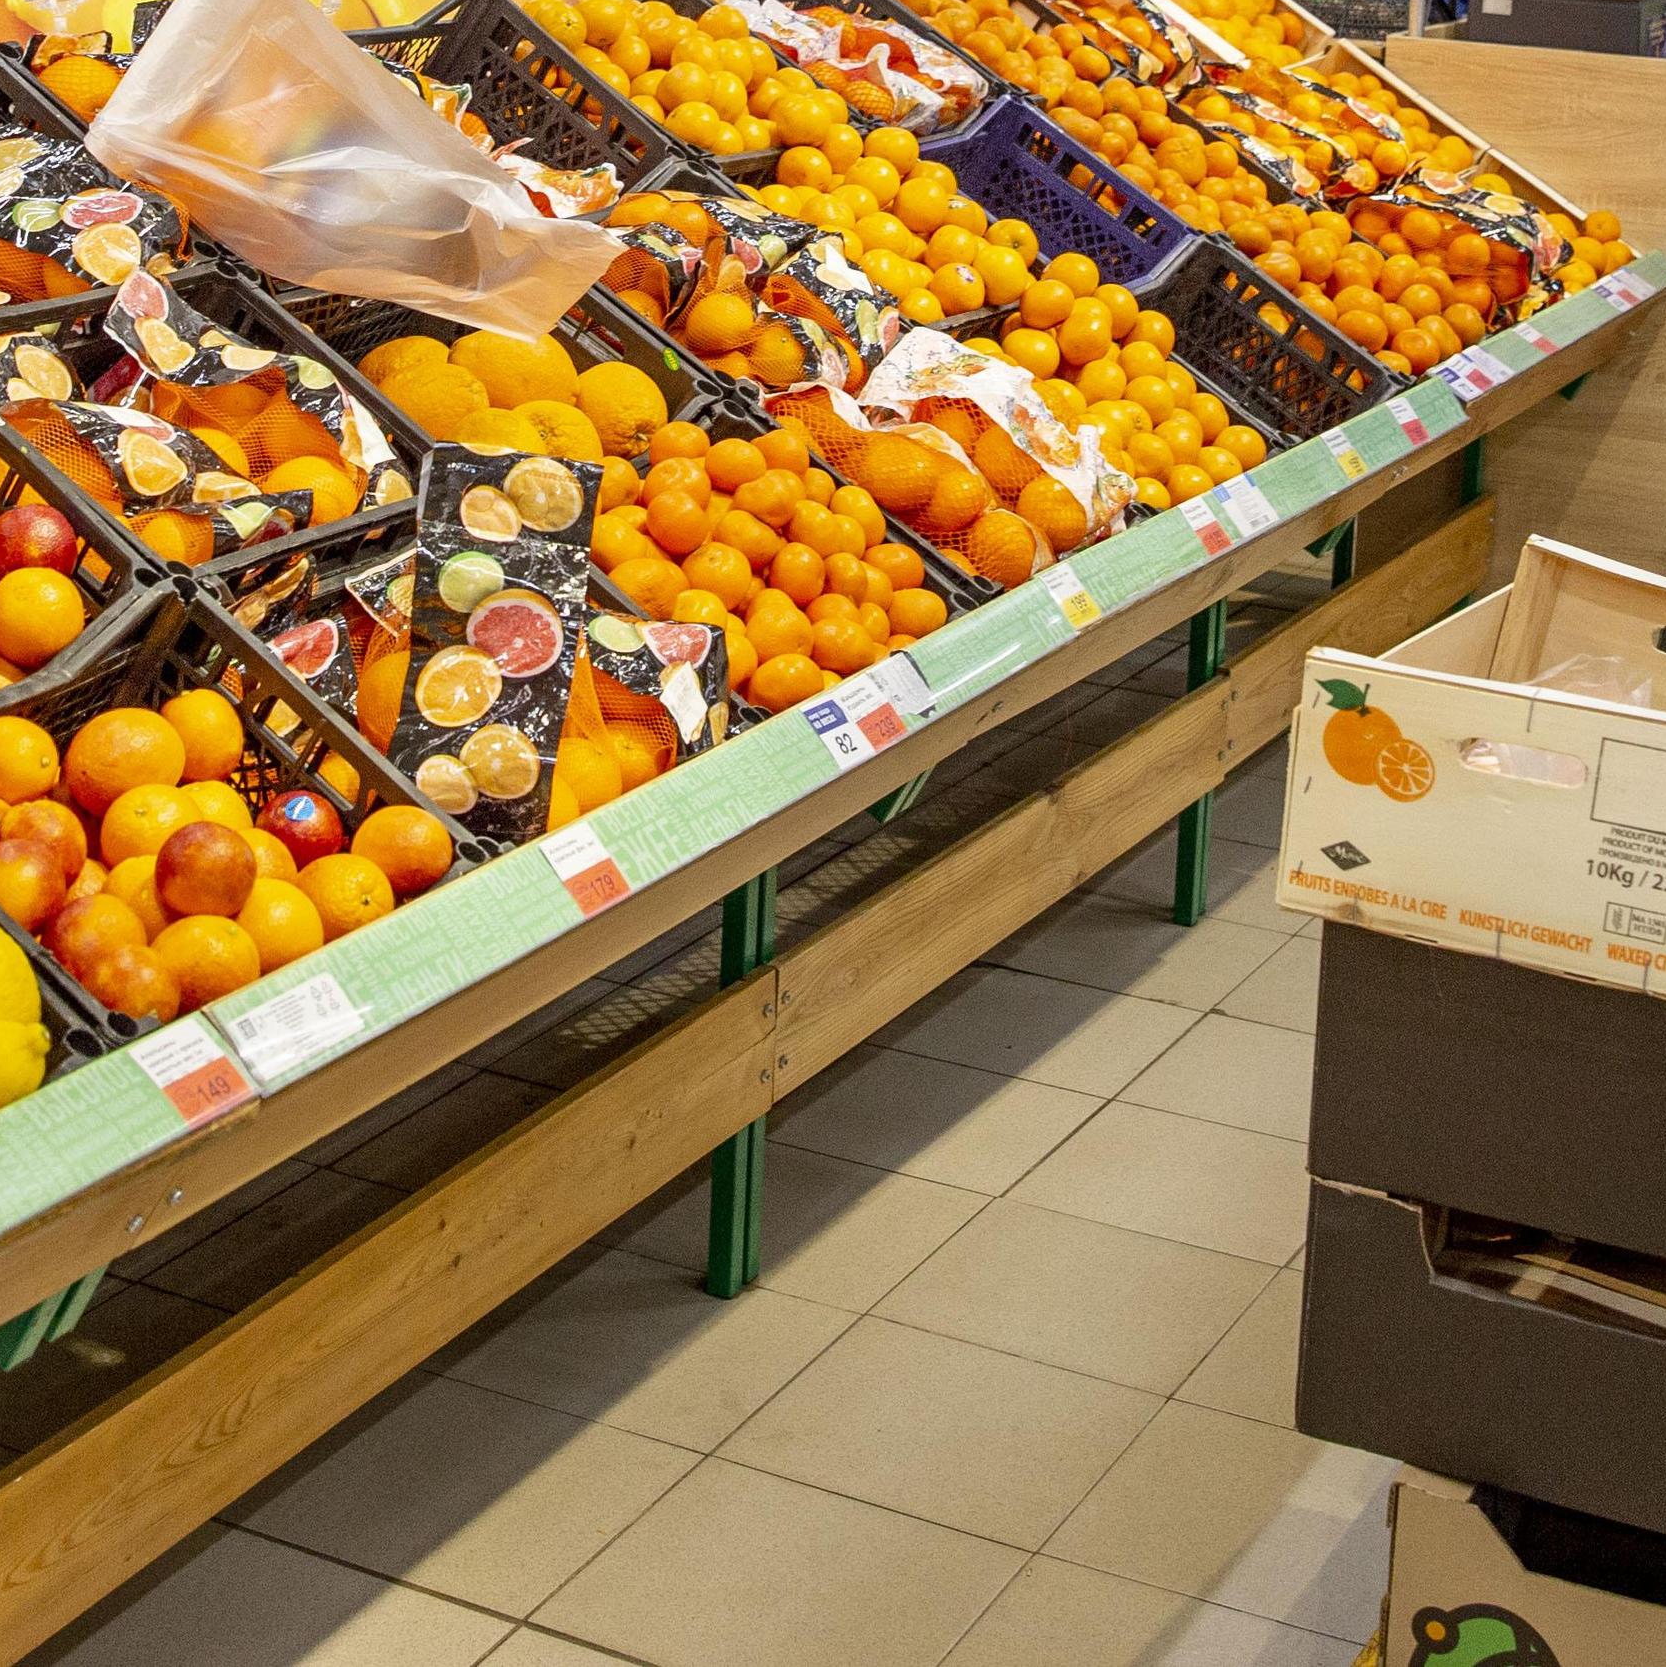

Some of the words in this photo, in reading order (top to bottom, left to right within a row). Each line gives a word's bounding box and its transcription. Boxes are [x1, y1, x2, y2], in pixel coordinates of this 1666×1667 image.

[837, 733, 857, 754] 82
[1602, 837, 1642, 852] PRODUCT
[1642, 844, 1654, 855] OF
[1611, 827, 1647, 842] PRODUIT
[1647, 834, 1661, 845] DU
[588, 872, 617, 900] 179
[1586, 859, 1635, 888] 10Kg
[1288, 870, 1332, 895] FRUITS
[1333, 876, 1389, 907] ENROBES
[1390, 891, 1400, 908] A
[1401, 893, 1418, 913] LA
[1419, 897, 1448, 921] CIRE
[1459, 907, 1530, 941] KUNSTLICH
[1531, 920, 1593, 955] GEWACHT
[1607, 942, 1653, 968] WAXED
[389, 948, 472, 1014] ДЕНЬГИ
[21, 1049, 144, 1134] ВЫСОКОЕ
[195, 1074, 232, 1107] 149
